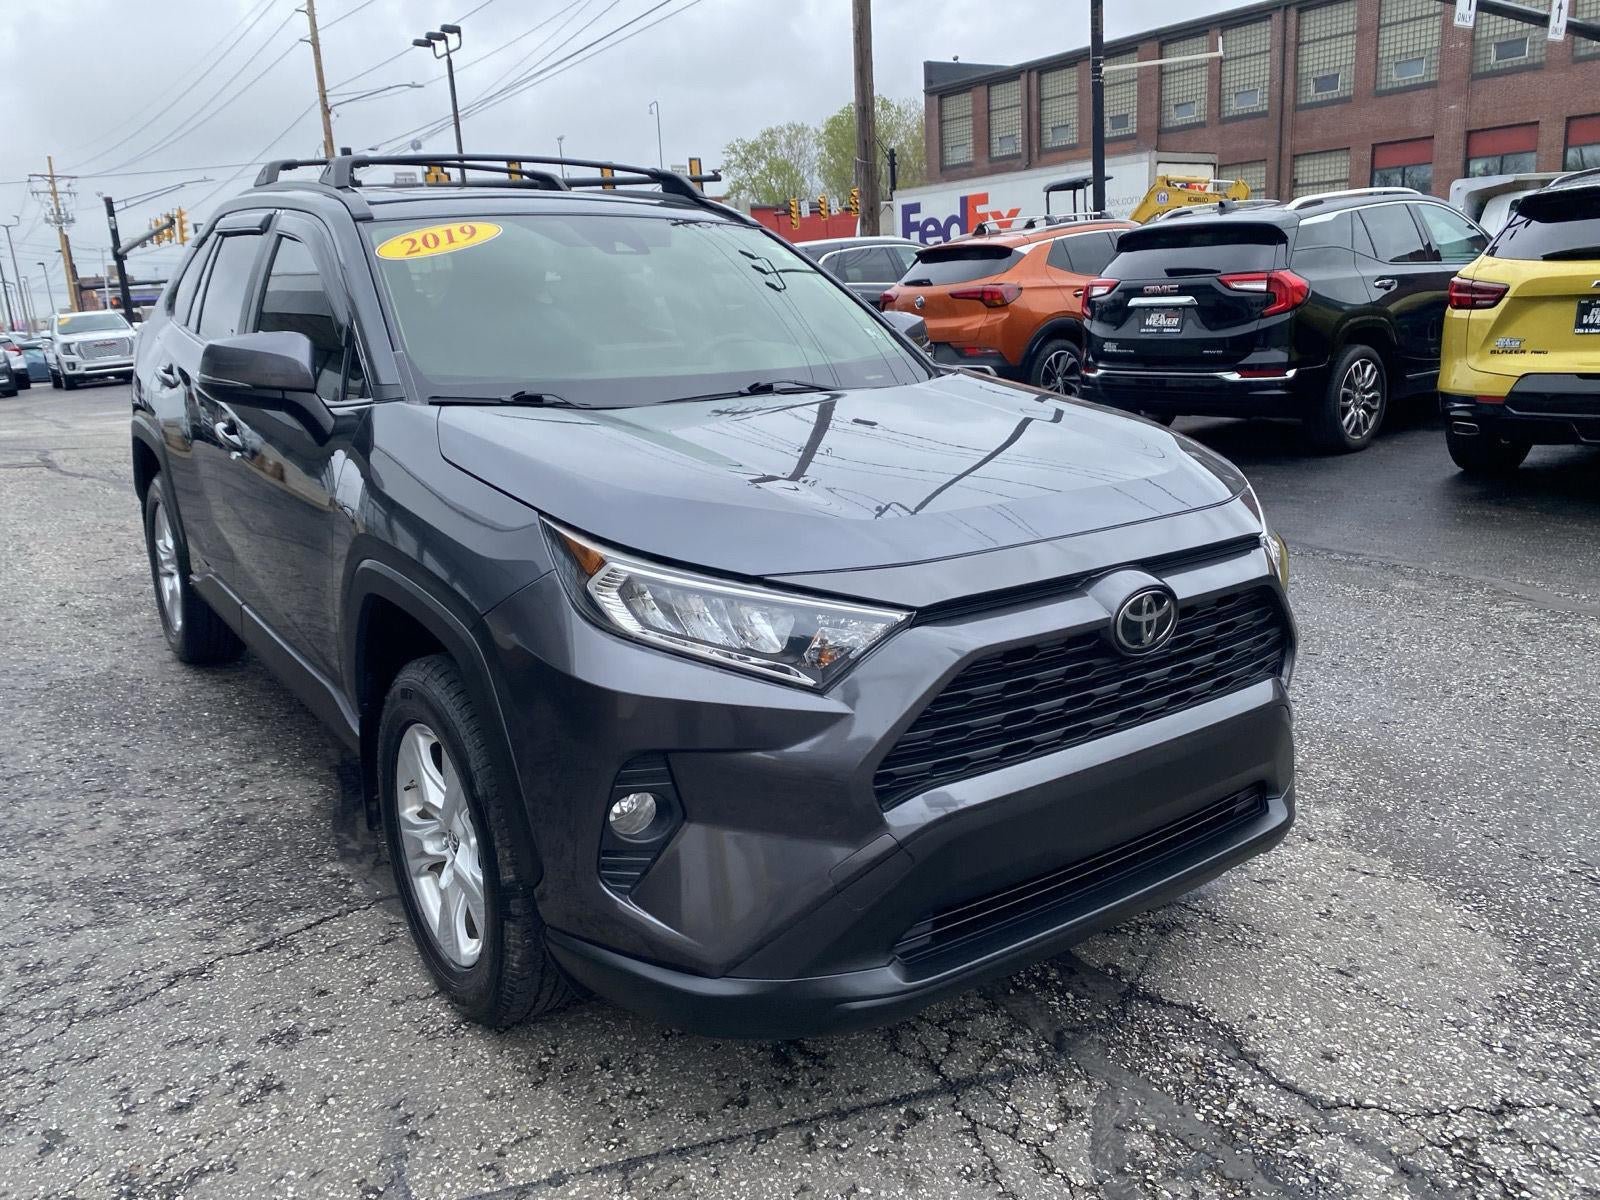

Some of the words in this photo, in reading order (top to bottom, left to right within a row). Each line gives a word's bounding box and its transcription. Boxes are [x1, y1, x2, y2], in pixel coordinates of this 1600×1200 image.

[1457, 12, 1472, 23] ONLY
[1551, 26, 1564, 35] ONLY
[1106, 196, 1142, 207] dex.com
[901, 192, 1022, 246] FedEx
[401, 224, 477, 256] 2019
[1143, 284, 1179, 295] GMC
[1145, 317, 1179, 325] WEAVER
